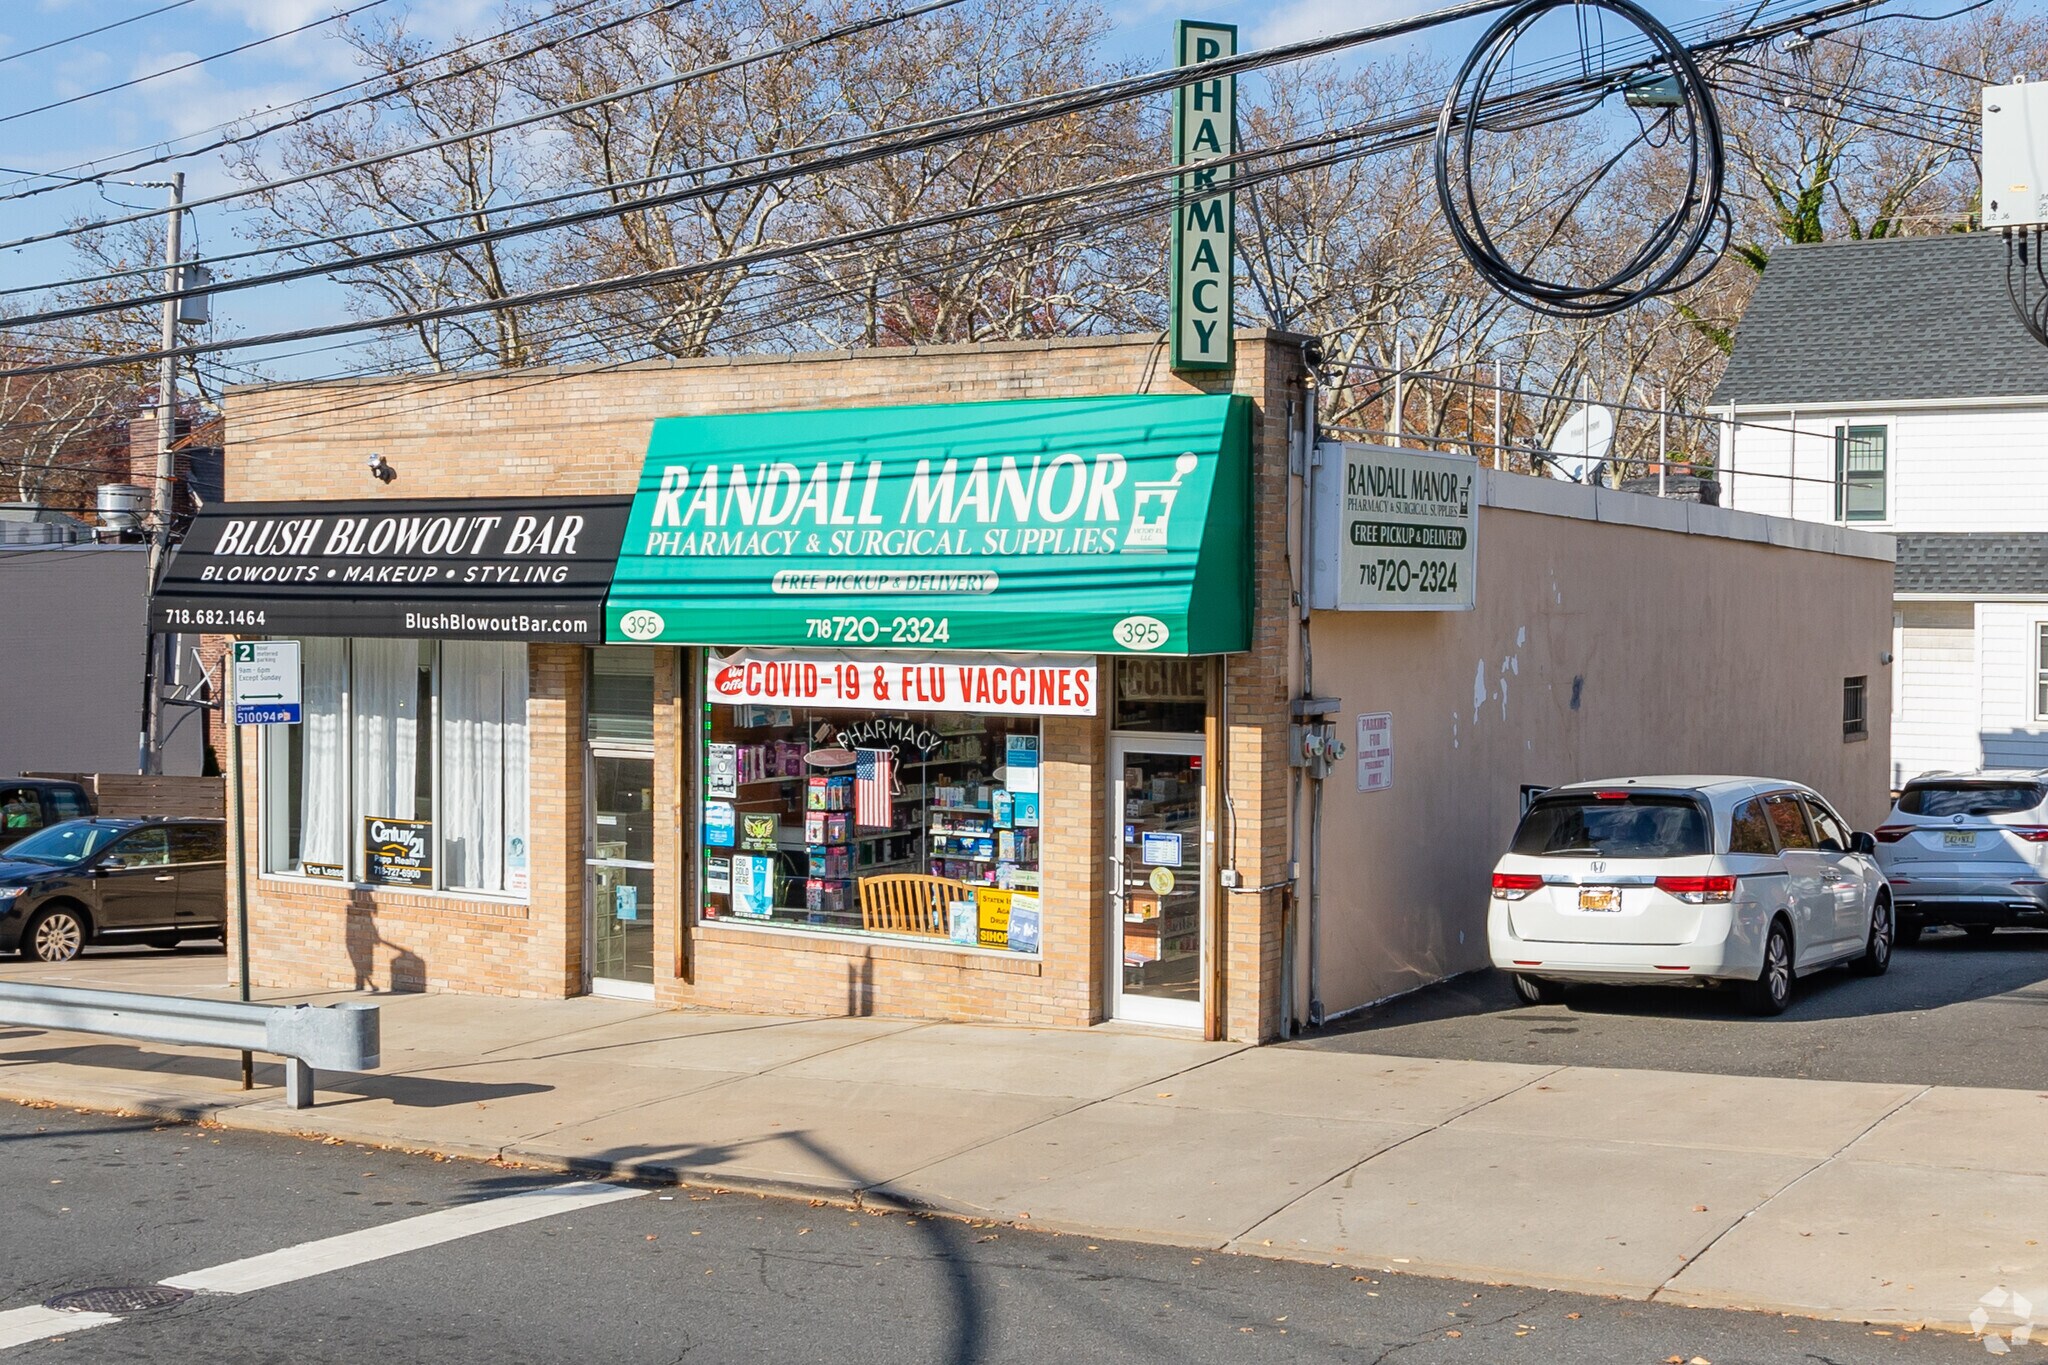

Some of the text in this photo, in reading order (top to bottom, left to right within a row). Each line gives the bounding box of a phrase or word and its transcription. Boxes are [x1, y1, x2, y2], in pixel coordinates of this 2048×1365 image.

[1187, 37, 1225, 354] PHARMACY
[650, 453, 1127, 527] RANDALL MANOR
[1348, 463, 1458, 503] RANDALL MANOR
[1347, 498, 1389, 513] PHARMACY
[1395, 503, 1428, 516] SURGICAL
[1430, 505, 1458, 518] SUPPLIES
[214, 516, 584, 556] BLUSH BLOWOUT BAR
[645, 527, 1116, 556] PHARMACY & SURGICAL SUPPLIES
[1355, 524, 1463, 547] FREE PICKUP & DELIVERY
[201, 565, 568, 583] BLOWOUTS MAKEUP STYLING
[780, 573, 990, 592] FREE PICKUP & DELIVERY
[166, 609, 266, 626] 718.682.1464
[406, 613, 587, 633] BlushBlowoutBar.com
[628, 615, 657, 634] 395
[1122, 623, 1159, 643] 395
[240, 645, 250, 661] 2
[746, 662, 1090, 707] COVID-19 & FLU VACCINES
[237, 711, 276, 723] 510094
[1362, 718, 1387, 731] PARKING
[836, 719, 942, 754] PHARMACY
[371, 821, 415, 845] Century
[307, 865, 320, 874] For
[395, 856, 420, 867] Realty
[735, 867, 749, 876] SOLD
[735, 876, 749, 885] HERE
[983, 895, 1004, 904] STATEN
